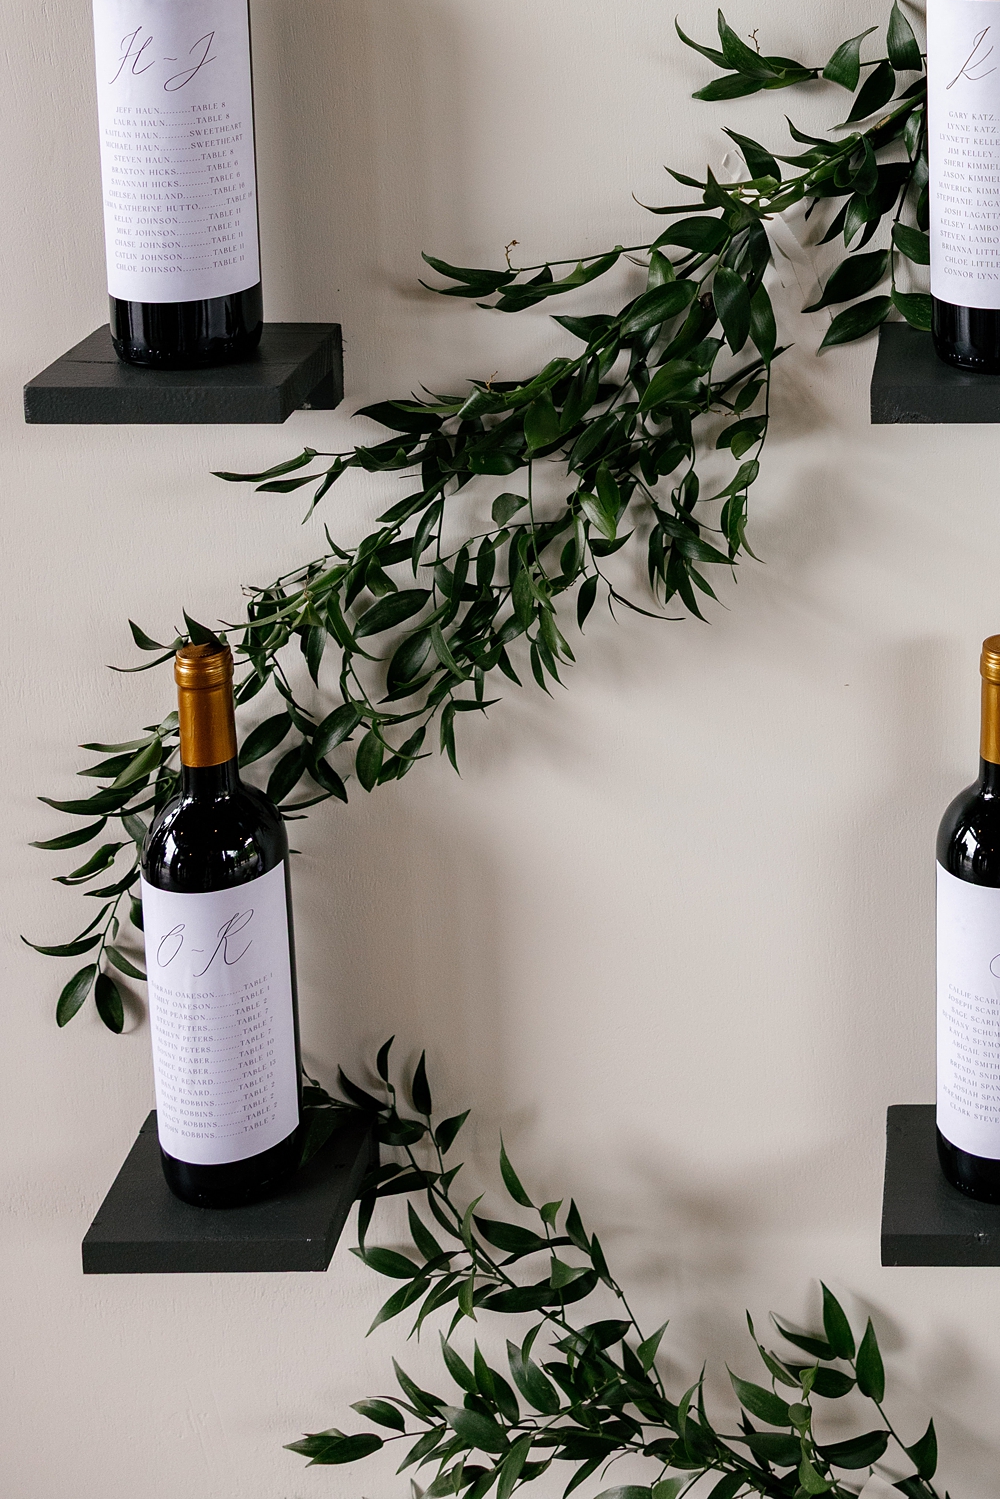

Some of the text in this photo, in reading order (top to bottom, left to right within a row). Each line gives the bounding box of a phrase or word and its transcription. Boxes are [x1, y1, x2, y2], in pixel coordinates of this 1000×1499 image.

[108, 26, 155, 85] H
[946, 26, 997, 90] K
[116, 106, 132, 114] JEFF
[191, 102, 218, 112] TABLE
[949, 111, 968, 119] GARY
[972, 113, 994, 121] KATZ
[106, 141, 132, 150] MICHAEL
[191, 134, 242, 149] SWEETHEART
[112, 166, 145, 175] BRAXTON
[207, 161, 231, 172] TABLE
[944, 159, 964, 168] SHERI
[967, 162, 1000, 171] KIMMEL
[944, 207, 961, 216] JOSH
[115, 239, 136, 248] CHASE
[139, 241, 181, 249] JOHNSON
[211, 233, 236, 244] TABLE
[944, 267, 974, 278] CONNOR
[977, 272, 999, 280] LYNN
[948, 983, 971, 1000] CALLIE
[170, 1010, 206, 1020] PEARSON
[235, 1002, 260, 1015] TABLE
[178, 1023, 208, 1031] PETERS
[237, 1011, 262, 1025] TABLE
[178, 1066, 209, 1075] REABER
[238, 1054, 263, 1069] TABLE
[266, 1049, 274, 1058] 10
[957, 1052, 972, 1064] SAM
[974, 1060, 1000, 1070] SMITH
[954, 1072, 978, 1087] SARAH
[181, 1098, 215, 1107] ROBBINS
[244, 1084, 269, 1100] TABLE
[950, 1102, 971, 1117] CLARK
